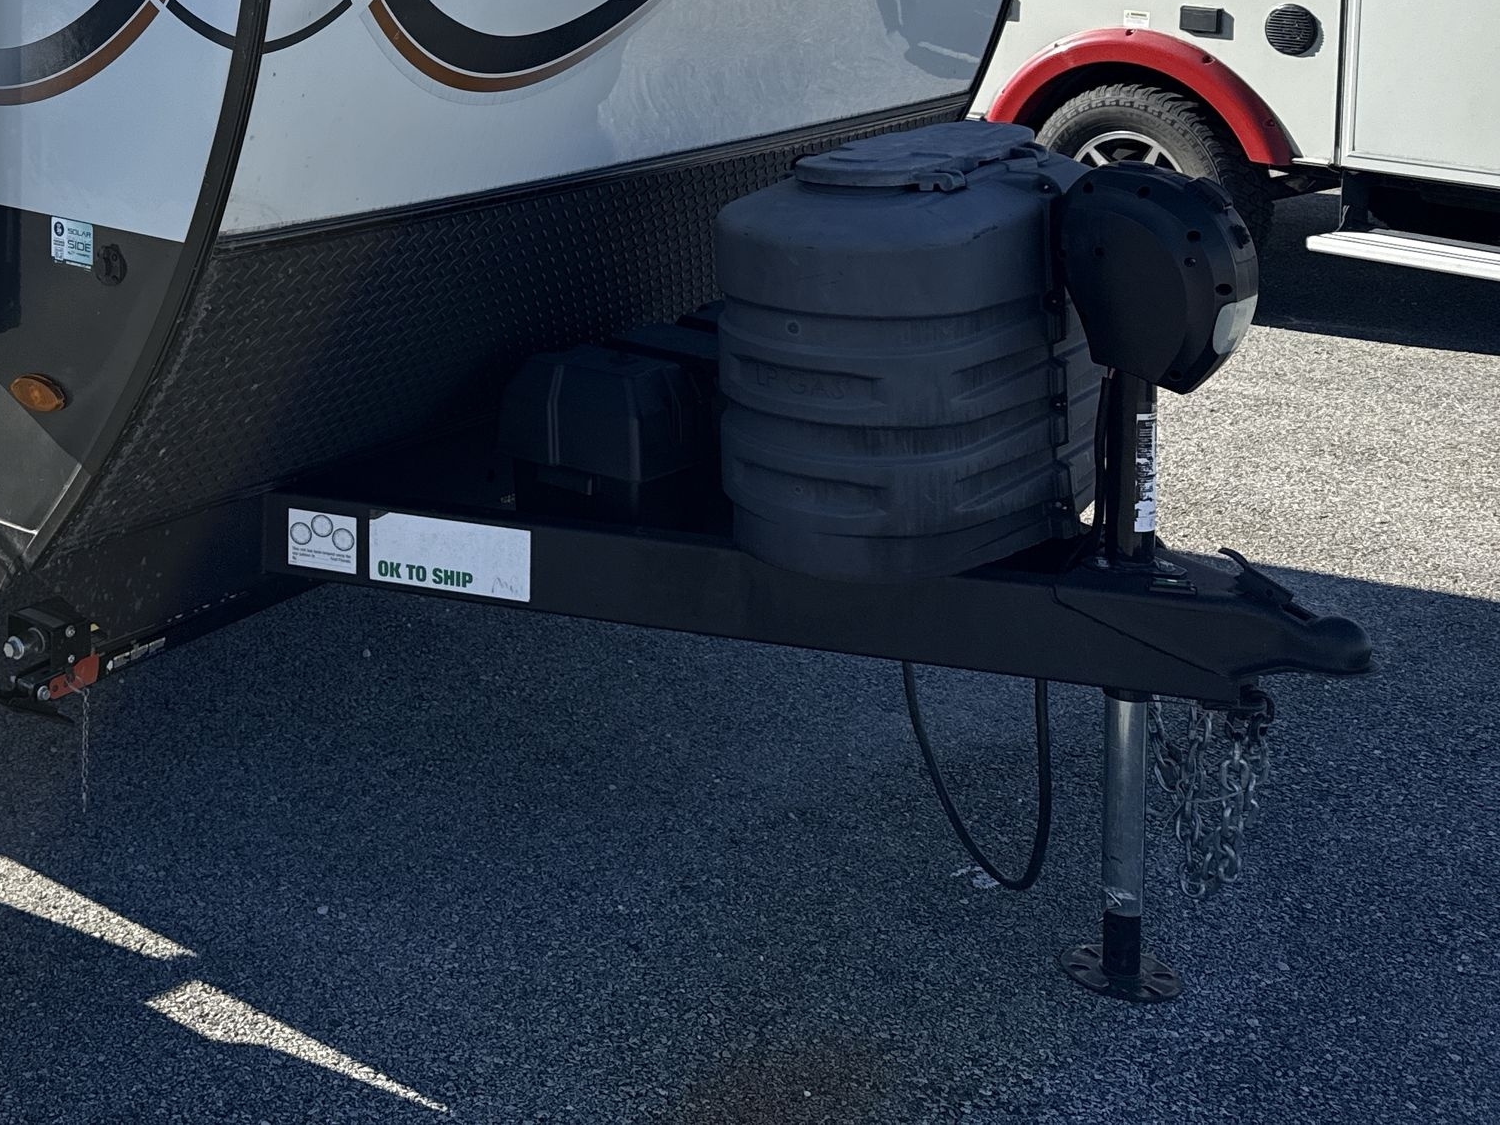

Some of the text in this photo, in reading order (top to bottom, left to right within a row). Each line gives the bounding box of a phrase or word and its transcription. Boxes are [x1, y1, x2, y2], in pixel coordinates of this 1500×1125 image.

[67, 228, 92, 238] SOLAR
[67, 240, 92, 253] SIDE
[756, 363, 846, 401] LP GAS
[377, 560, 402, 579] OK
[405, 564, 427, 582] TO
[432, 567, 474, 588] SHIP
